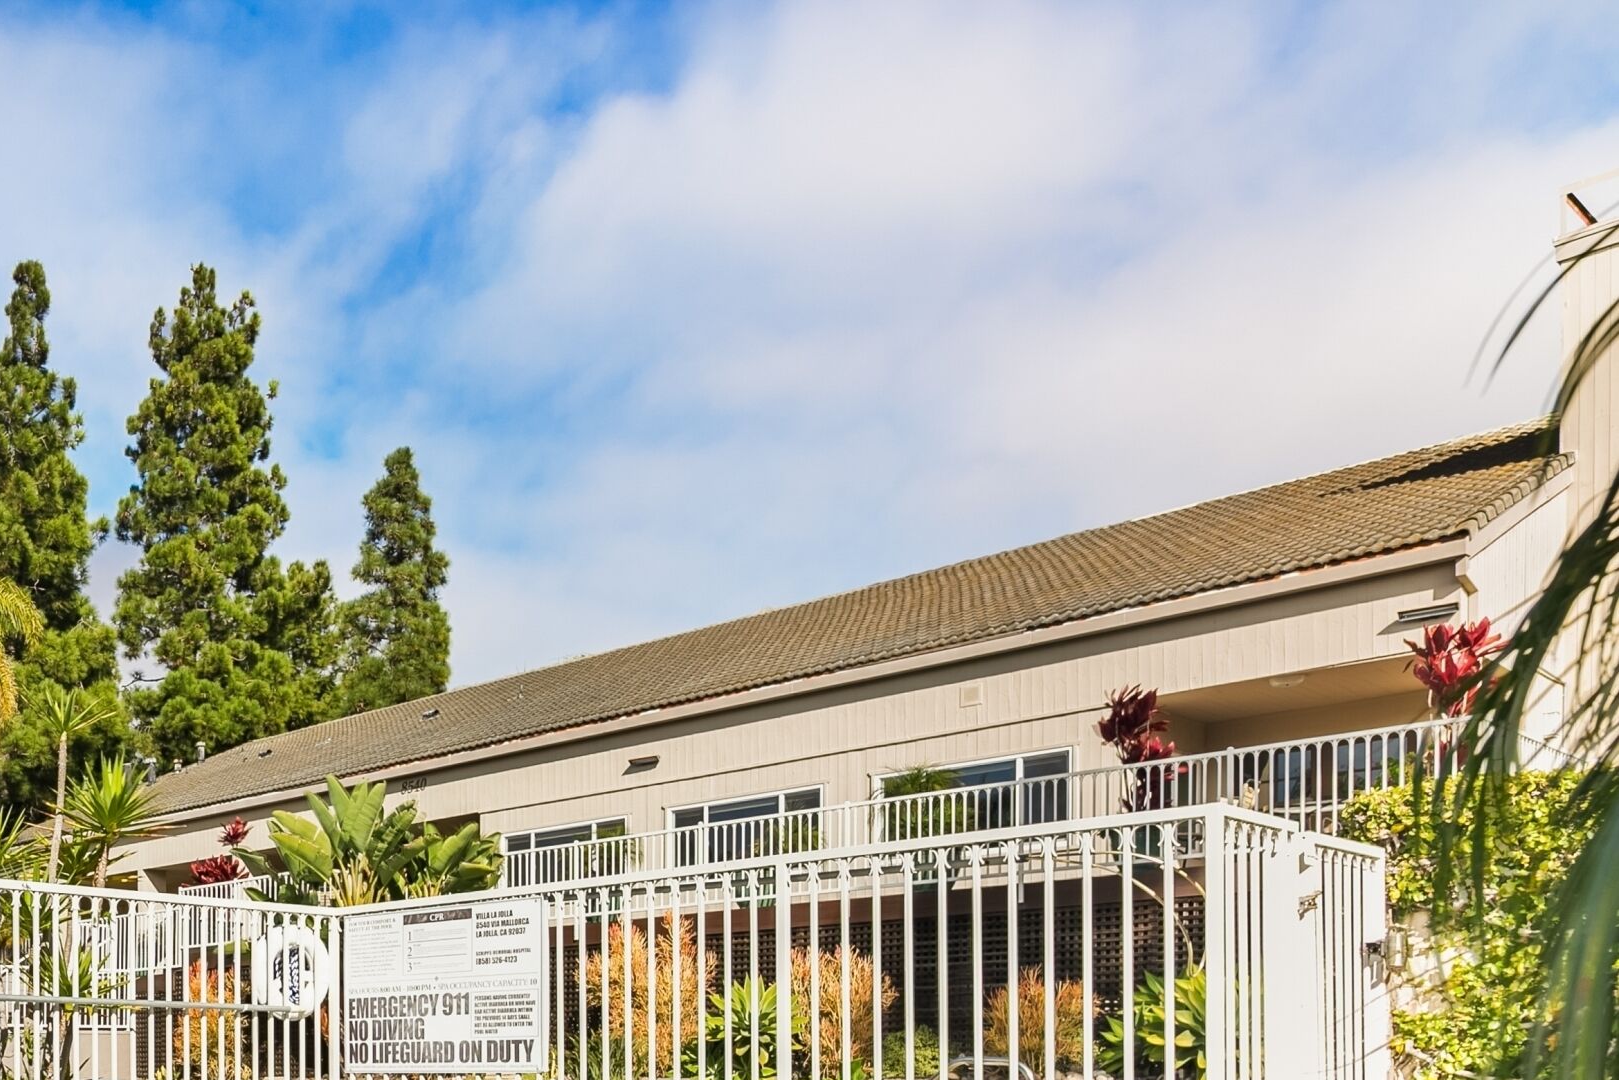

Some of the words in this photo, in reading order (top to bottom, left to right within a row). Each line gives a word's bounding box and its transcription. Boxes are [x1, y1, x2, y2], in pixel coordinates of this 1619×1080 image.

[401, 777, 427, 795] 8540
[429, 913, 445, 921] CPR
[476, 912, 490, 920] VILLA
[498, 909, 513, 917] JOLLA
[476, 921, 490, 929] 8540
[501, 918, 530, 926] MALLORCA
[500, 928, 507, 936] CA
[493, 979, 528, 987] CAPACITY
[349, 993, 439, 1019] EMERGENCY
[442, 992, 470, 1016] 911
[349, 1020, 369, 1041] NO
[372, 1018, 425, 1041] DIVING
[349, 1043, 369, 1064] NO
[372, 1041, 455, 1064] LIFEGUARD
[459, 1041, 483, 1063] ON
[486, 1039, 535, 1063] DUTY
